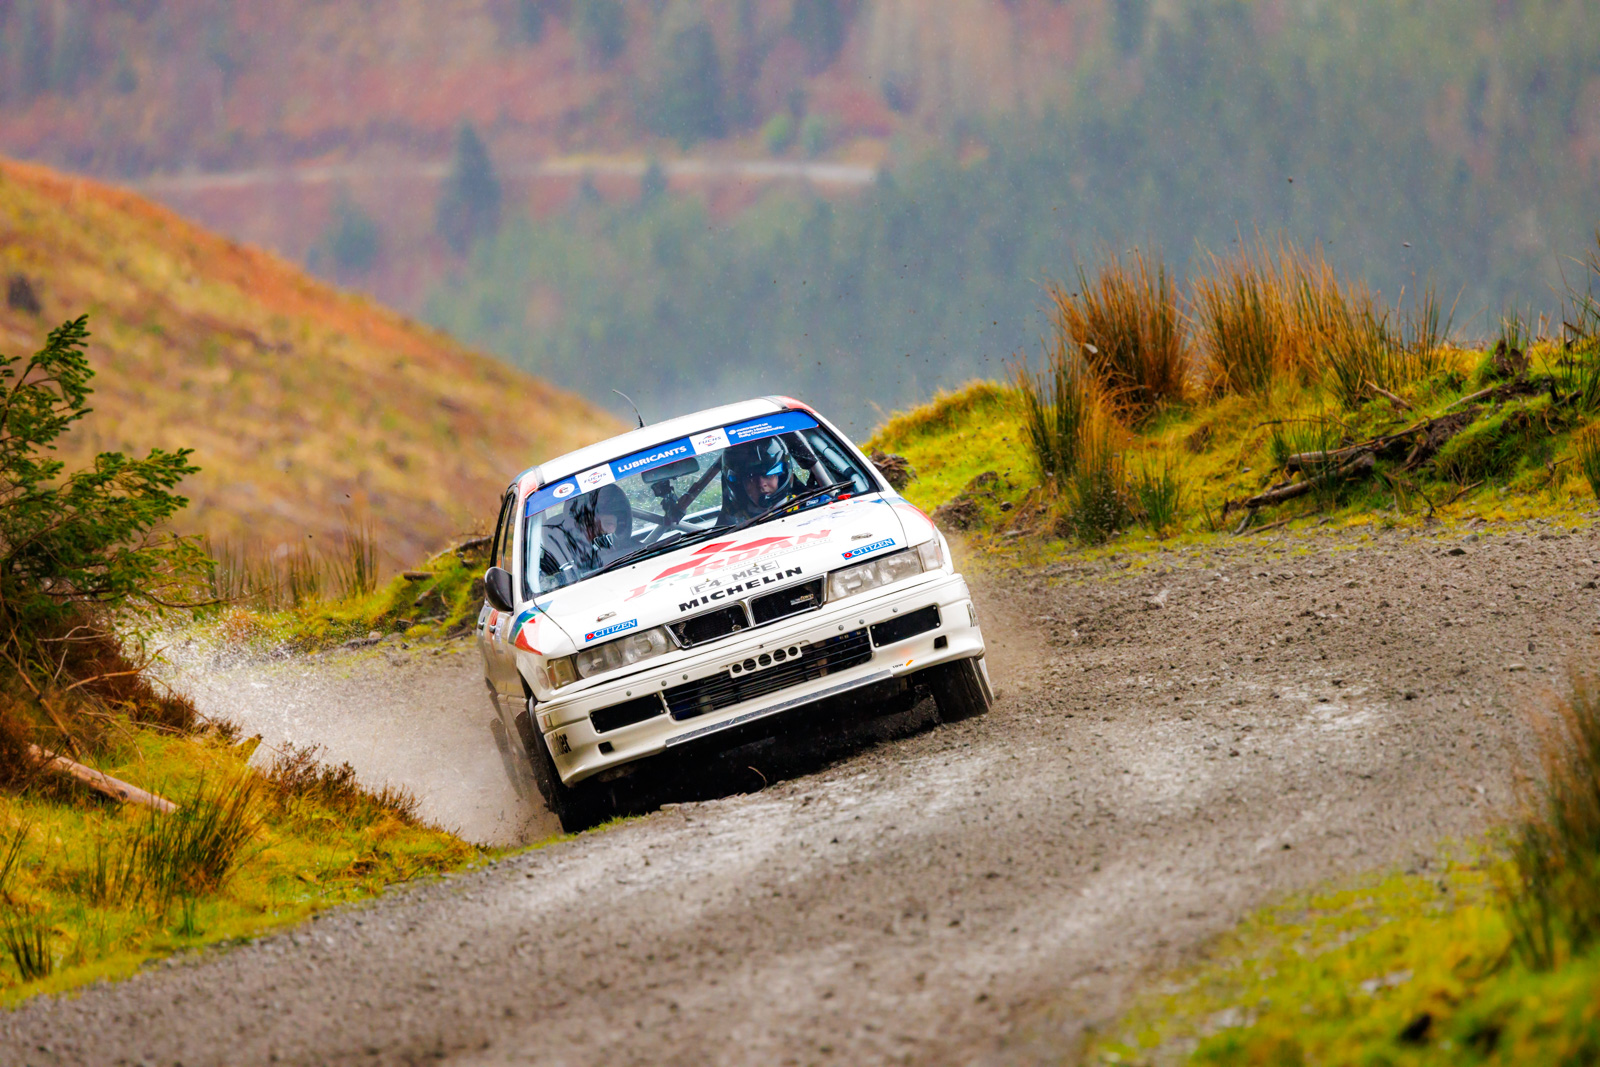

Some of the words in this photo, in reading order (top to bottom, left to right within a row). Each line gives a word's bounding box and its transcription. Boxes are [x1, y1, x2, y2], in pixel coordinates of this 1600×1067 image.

[751, 425, 785, 435] Championship
[698, 436, 722, 446] FUCHS
[617, 445, 687, 473] LUBRICANTS
[583, 472, 607, 484] FUCHS
[851, 538, 893, 556] CITIZEN
[731, 561, 777, 580] MRE
[678, 566, 803, 612] MICHELIN
[594, 620, 636, 638] CITIZEN
